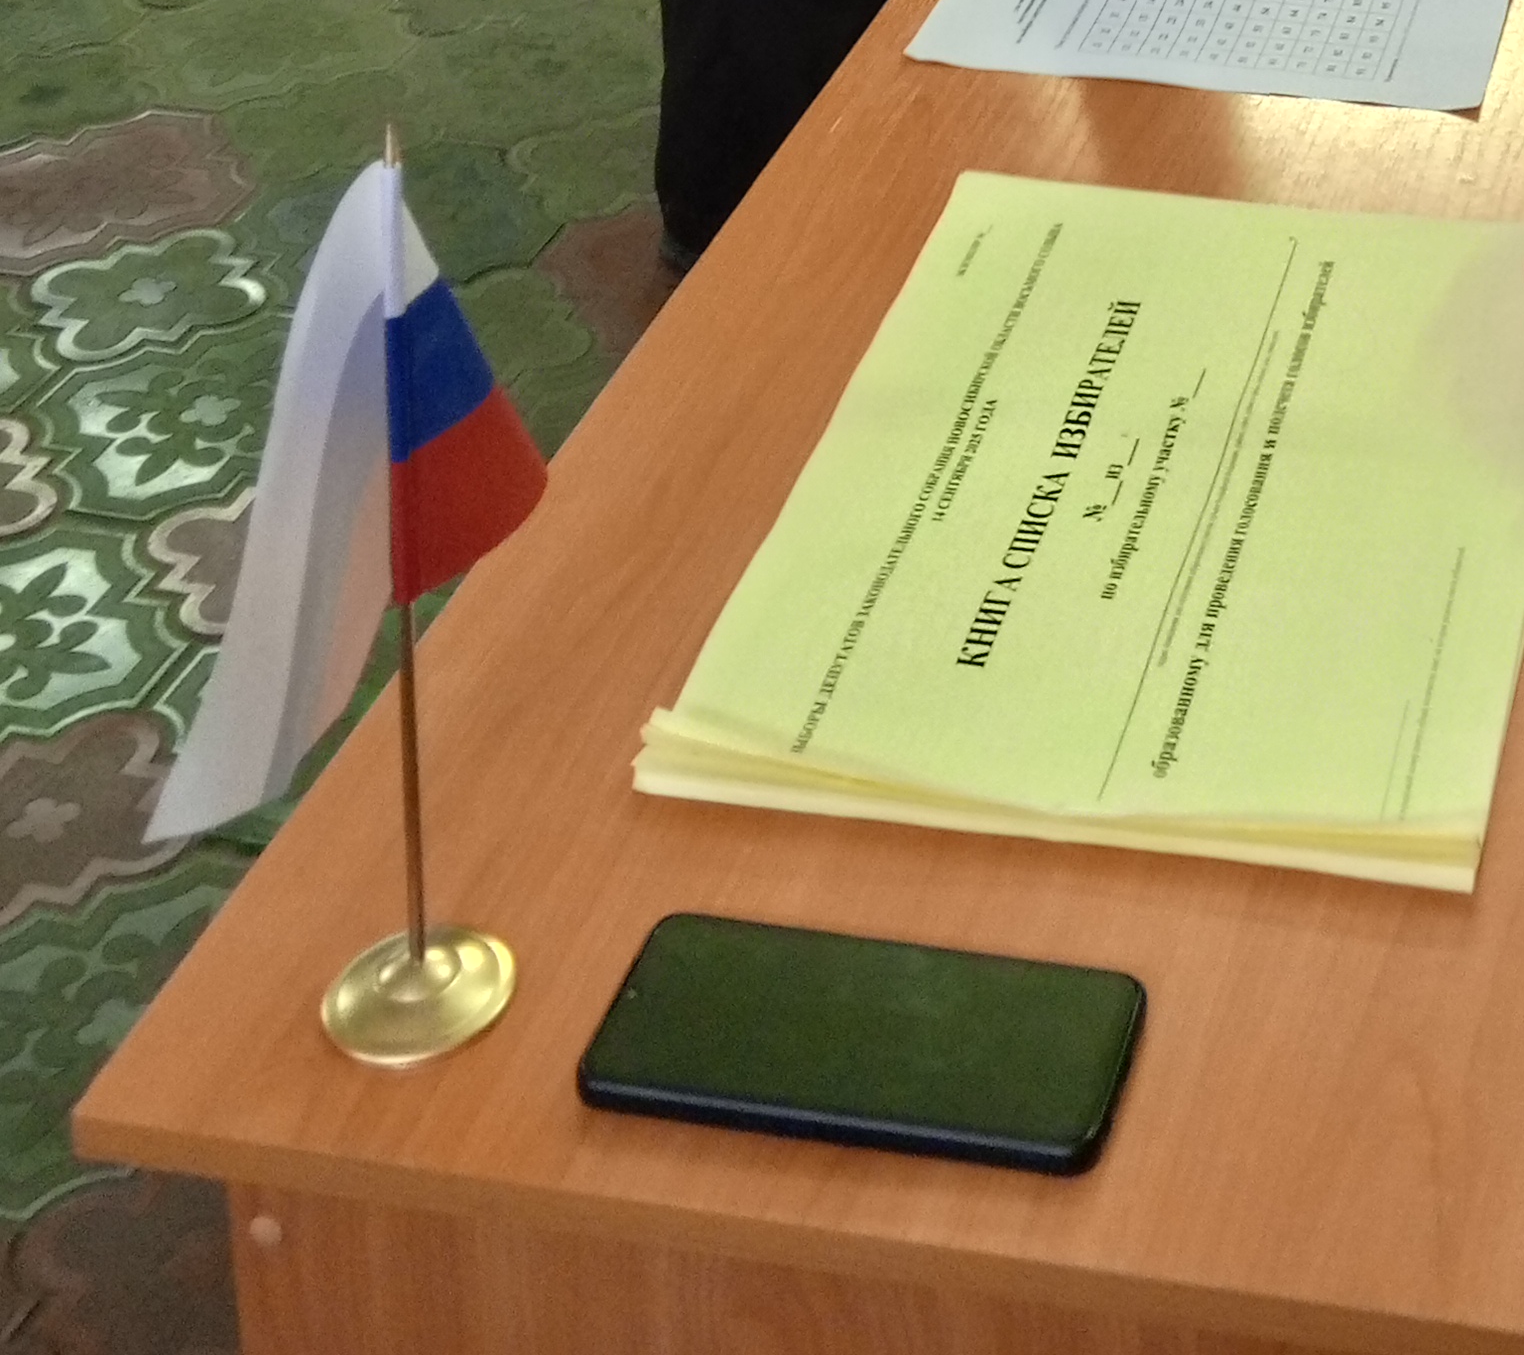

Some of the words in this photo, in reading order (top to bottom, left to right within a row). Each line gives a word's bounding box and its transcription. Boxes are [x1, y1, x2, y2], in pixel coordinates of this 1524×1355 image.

[966, 433, 983, 455] 2025
[974, 399, 998, 433] ГОДА
[819, 620, 865, 699] ДЕПУТАТОВ
[857, 503, 926, 620] ЗАКОНОДАТЕЛЬНОГО
[919, 443, 957, 502] СОБРАНИЯ
[948, 350, 999, 446] НОВОСИБИРСКОЙ
[932, 508, 945, 522] 14
[938, 456, 973, 510] СЕНТЯБРЯ
[956, 576, 1023, 667] КНИГА
[1002, 471, 1070, 569] СПИСКА
[1051, 300, 1141, 460] ИЗБИРАТЕЛЕЙ
[1101, 581, 1119, 600] по
[1110, 475, 1165, 581] избирательному
[1154, 415, 1187, 475] участку
[1151, 654, 1210, 779] образованному
[1196, 622, 1216, 652] для
[1206, 537, 1244, 618] проведения
[1235, 452, 1273, 539] голосования
[1264, 439, 1277, 450] и
[1302, 260, 1335, 331] избирателей
